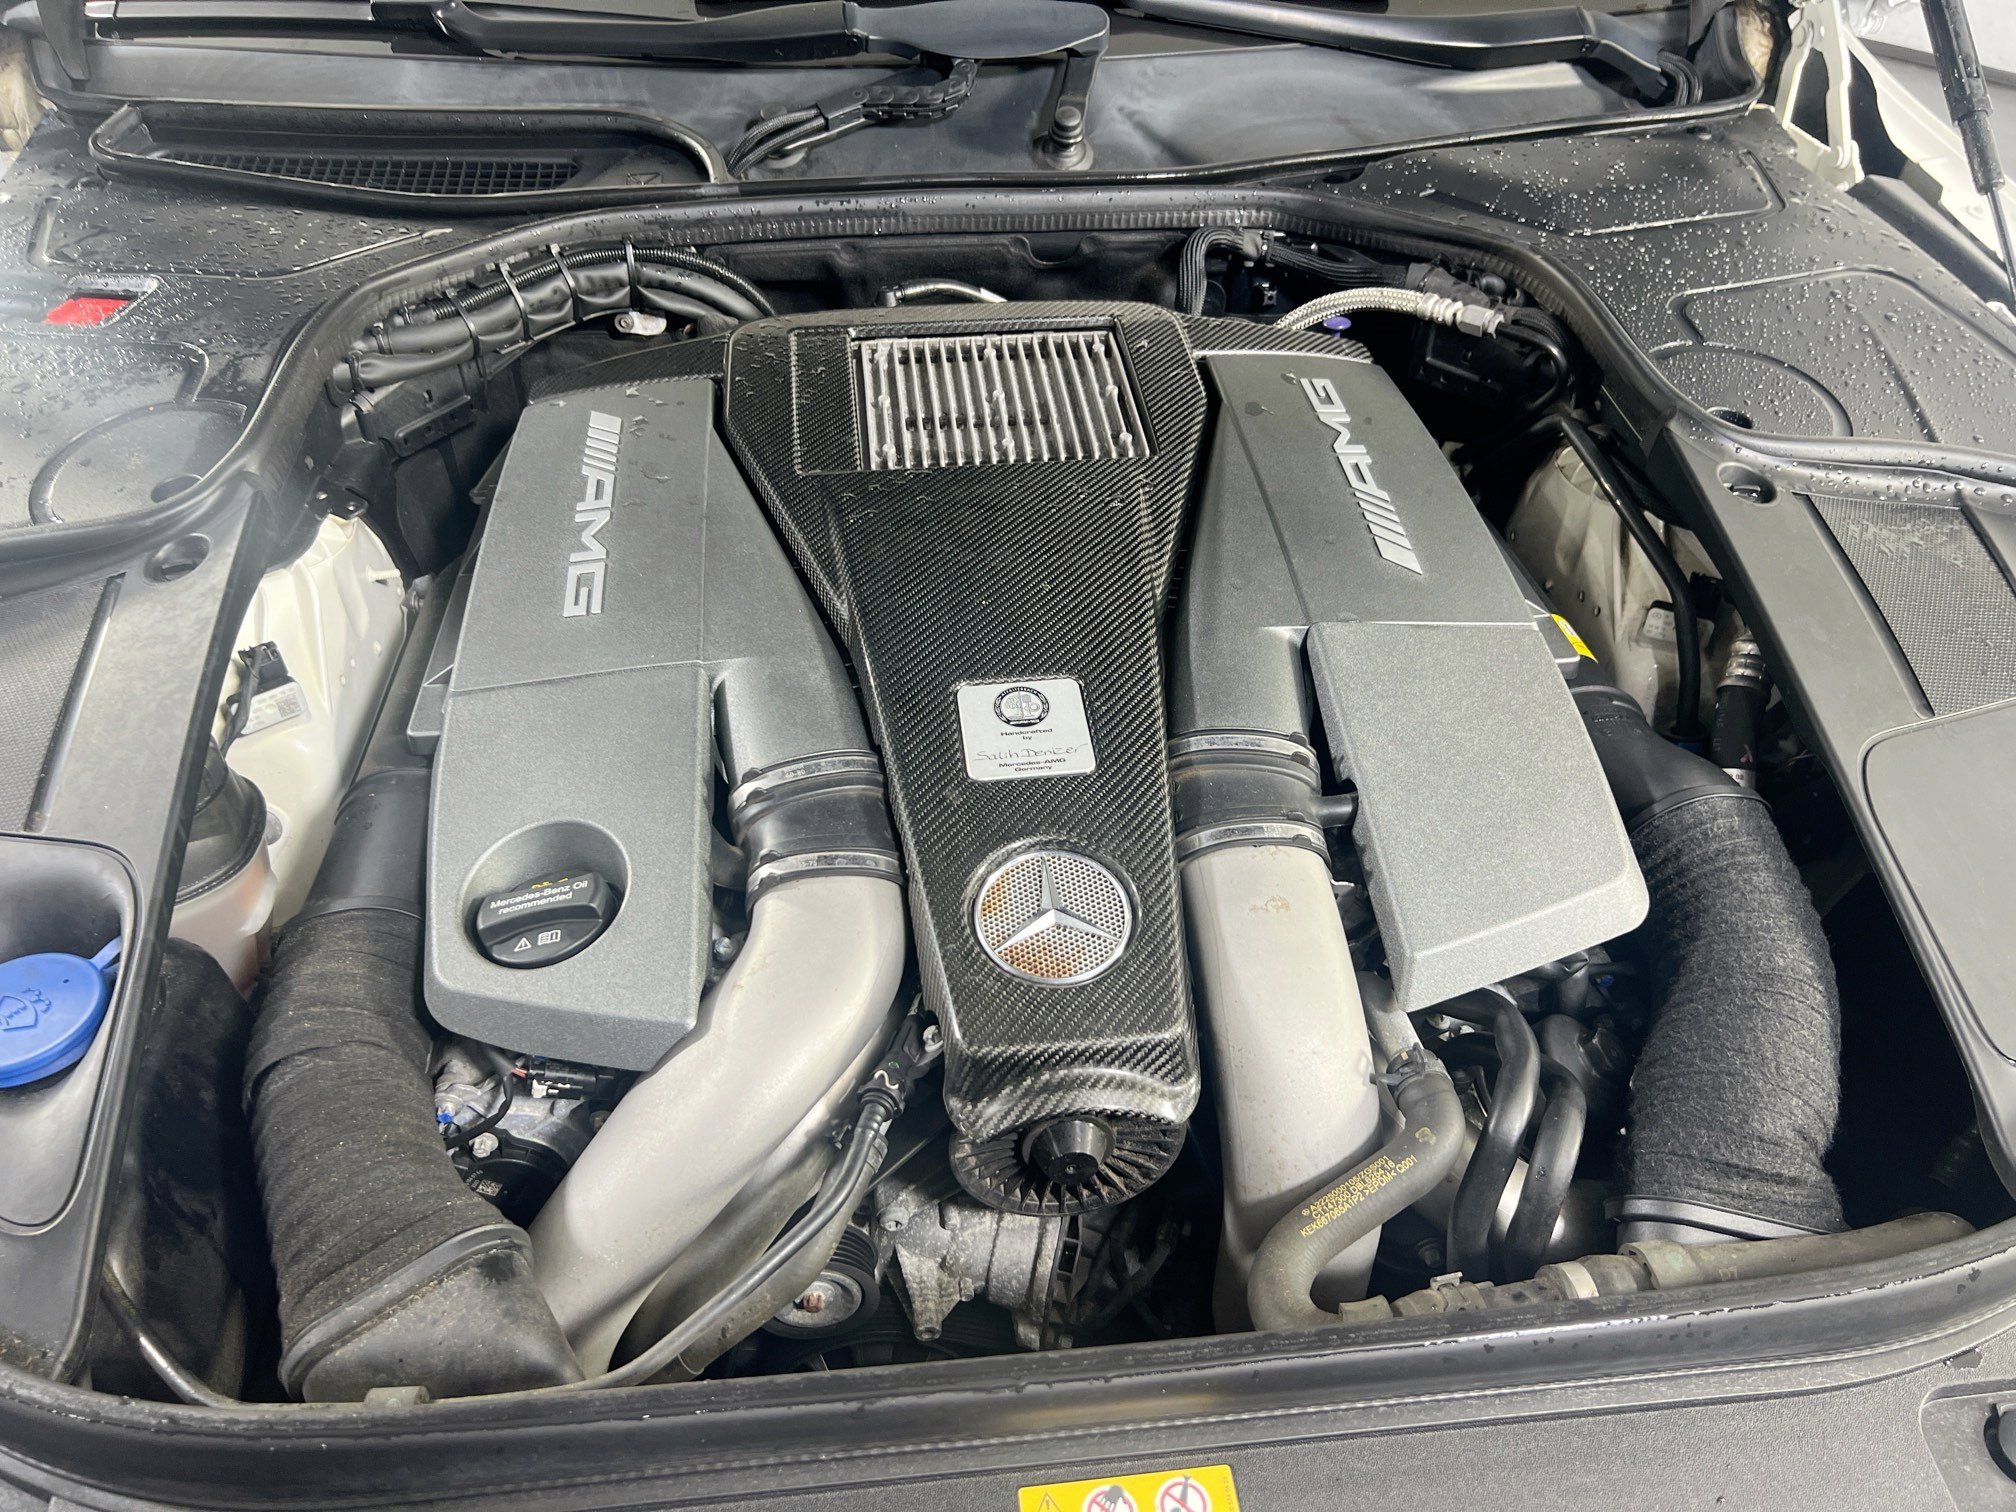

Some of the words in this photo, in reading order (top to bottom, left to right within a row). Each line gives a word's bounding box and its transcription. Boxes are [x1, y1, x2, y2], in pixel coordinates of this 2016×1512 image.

[563, 465, 616, 618] AMG
[1000, 728, 1053, 736] Handcrafted
[999, 758, 1066, 768] Mercedes-AMG
[490, 883, 571, 909] Mercedes-Benz
[573, 880, 588, 889] Oil
[499, 892, 573, 915] recommended
[1299, 1193, 1365, 1237] KEK667065A1P2
[1396, 1154, 1418, 1174] Q001
[1312, 1191, 1351, 1219] CT147300
